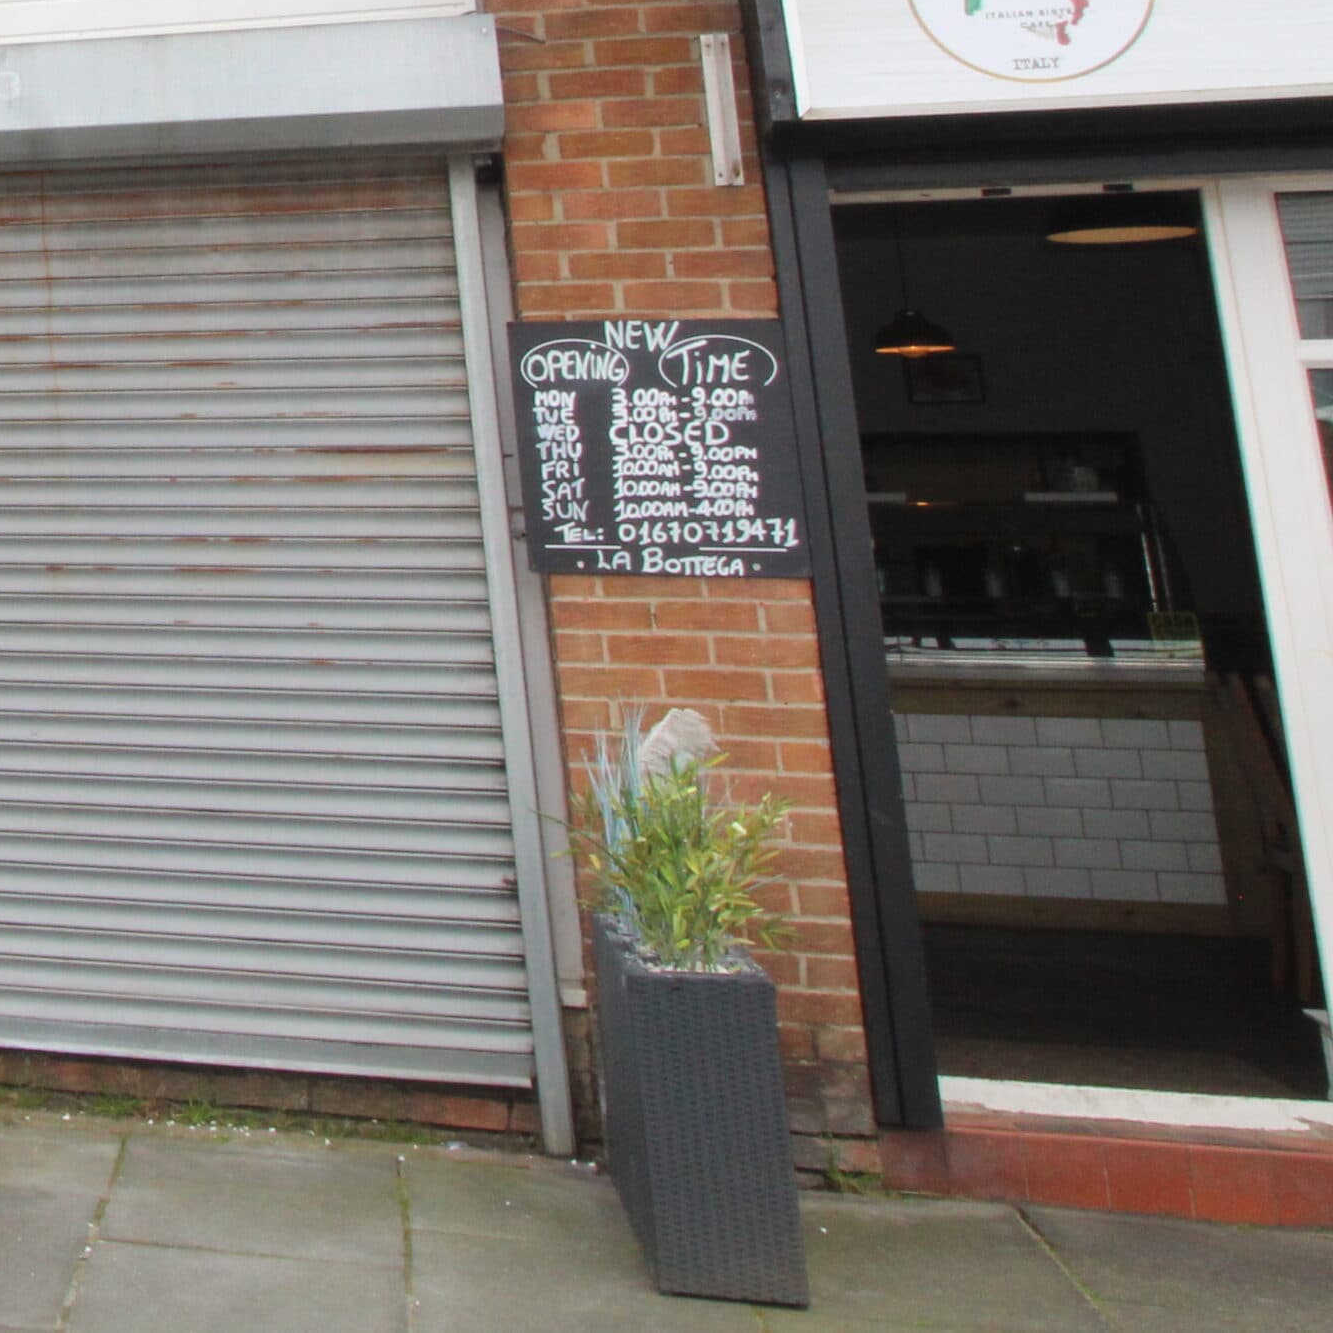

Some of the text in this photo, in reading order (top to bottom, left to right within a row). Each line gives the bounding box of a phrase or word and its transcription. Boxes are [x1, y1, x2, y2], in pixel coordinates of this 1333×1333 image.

[984, 9, 1034, 19] ITALIAN
[1013, 57, 1060, 71] ITALY
[604, 321, 679, 352] NEW
[535, 390, 577, 407] MON
[534, 408, 575, 425] TUE
[536, 421, 729, 446] WED CLOSED
[535, 442, 583, 460] THU
[542, 478, 586, 502] SAT
[542, 501, 589, 522] SUN
[554, 521, 604, 543] TEL:
[597, 547, 746, 577] LA BOTTEGA
